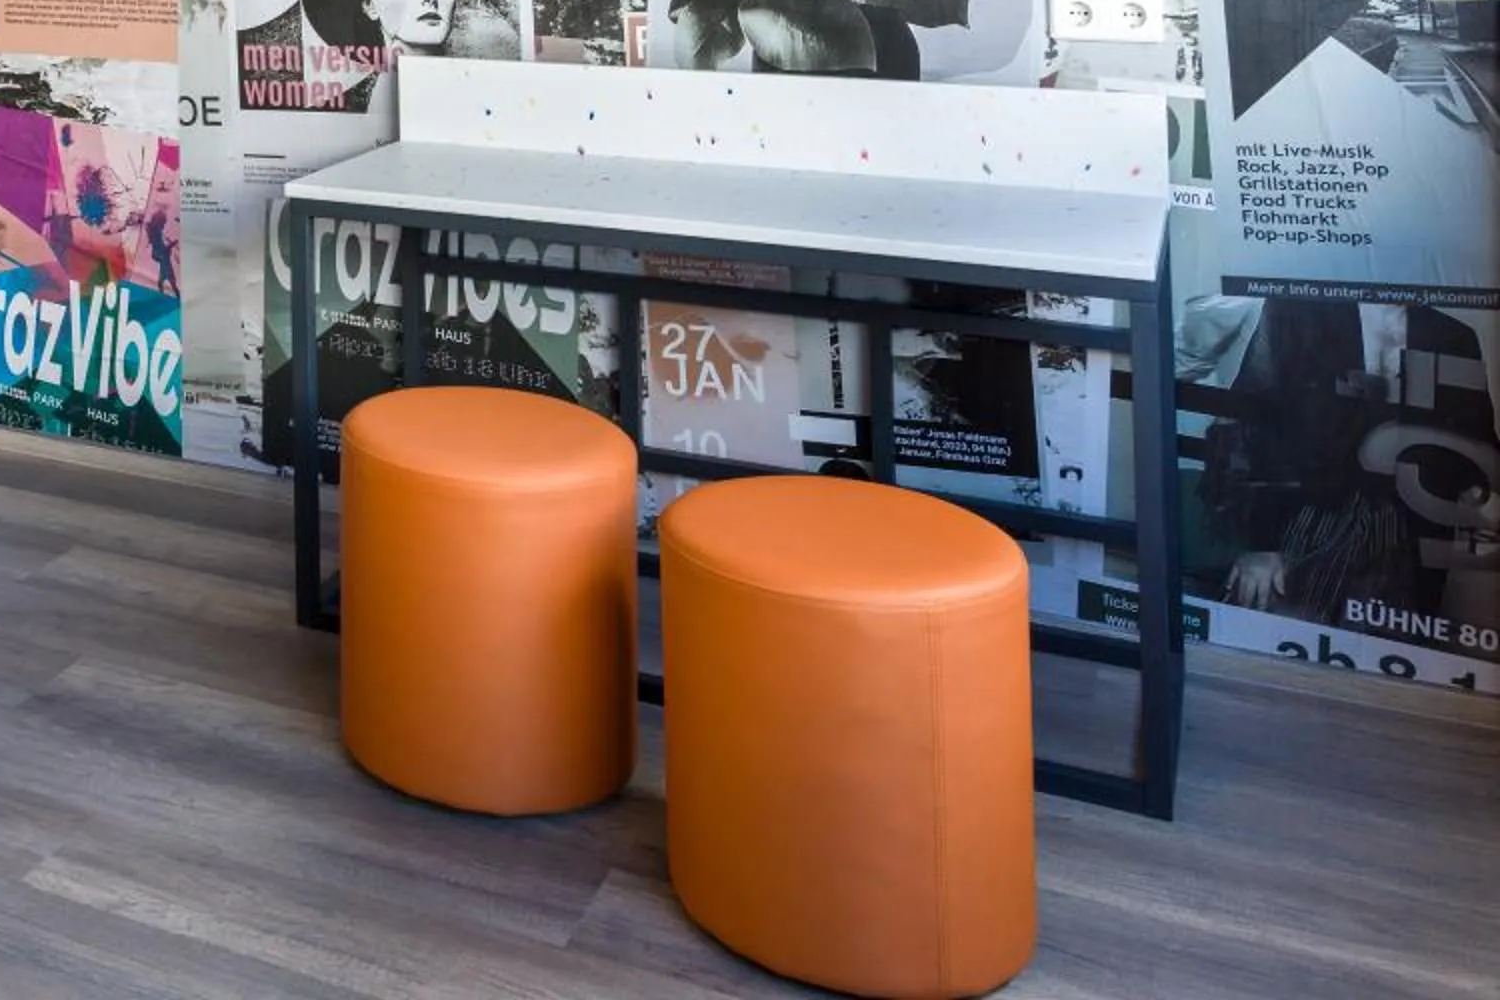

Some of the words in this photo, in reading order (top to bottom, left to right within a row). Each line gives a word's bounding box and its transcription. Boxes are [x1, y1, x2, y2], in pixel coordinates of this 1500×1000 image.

[242, 44, 300, 73] men
[242, 79, 345, 108] women
[1236, 145, 1267, 157] mit
[1272, 143, 1375, 159] Live-Musik
[1237, 159, 1288, 176] Rock,
[1295, 161, 1346, 177] Jazz,
[1353, 162, 1390, 179] Pop
[1238, 176, 1369, 193] Grillstationen
[1173, 190, 1201, 205] von
[1240, 192, 1286, 207] Food
[1291, 194, 1357, 210] Trucks
[1241, 210, 1339, 227] Flohmarkt
[1243, 227, 1373, 246] Pop-up-Shops
[1248, 281, 1284, 295] Mehr
[434, 326, 472, 345] HAUS
[660, 322, 716, 362] 27
[664, 353, 766, 403] JAN
[33, 391, 63, 410] PARK
[87, 406, 120, 426] HAUS
[1346, 598, 1450, 642] BÜHNE
[1458, 623, 1499, 651] 80
